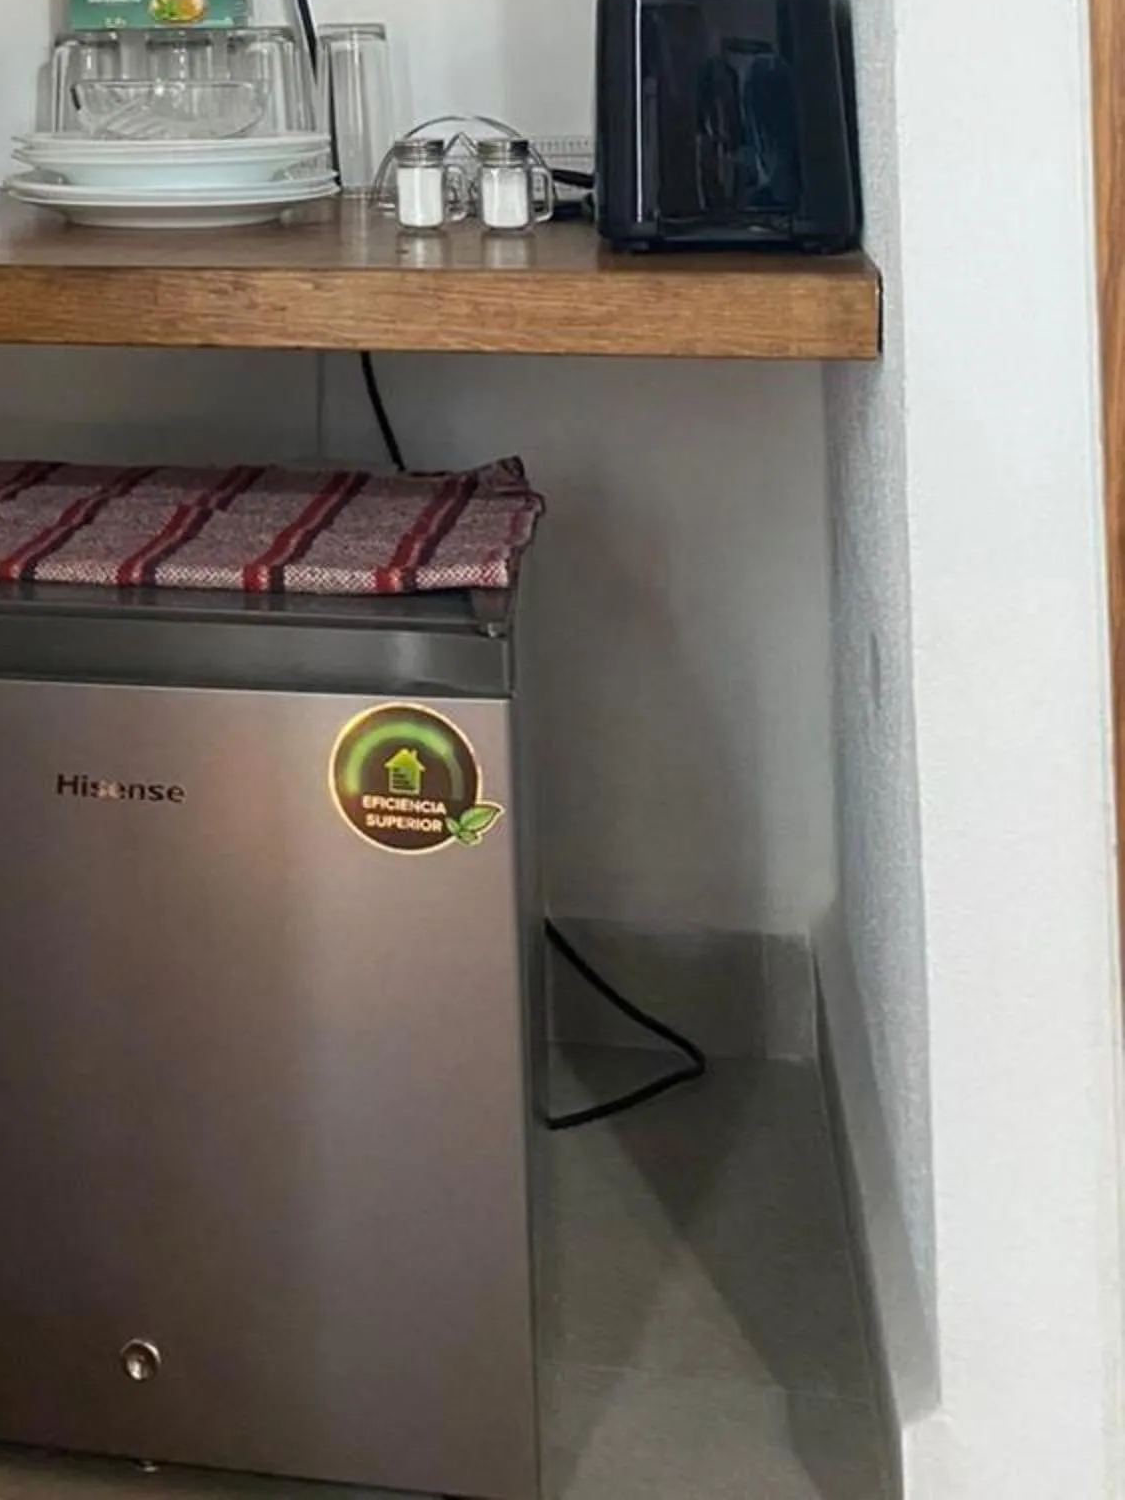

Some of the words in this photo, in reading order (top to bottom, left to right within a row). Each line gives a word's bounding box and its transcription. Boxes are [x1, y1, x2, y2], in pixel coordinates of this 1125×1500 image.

[56, 773, 187, 803] Hisense
[362, 794, 447, 815] EFICIENCIA
[365, 813, 444, 833] SUPERIOR
